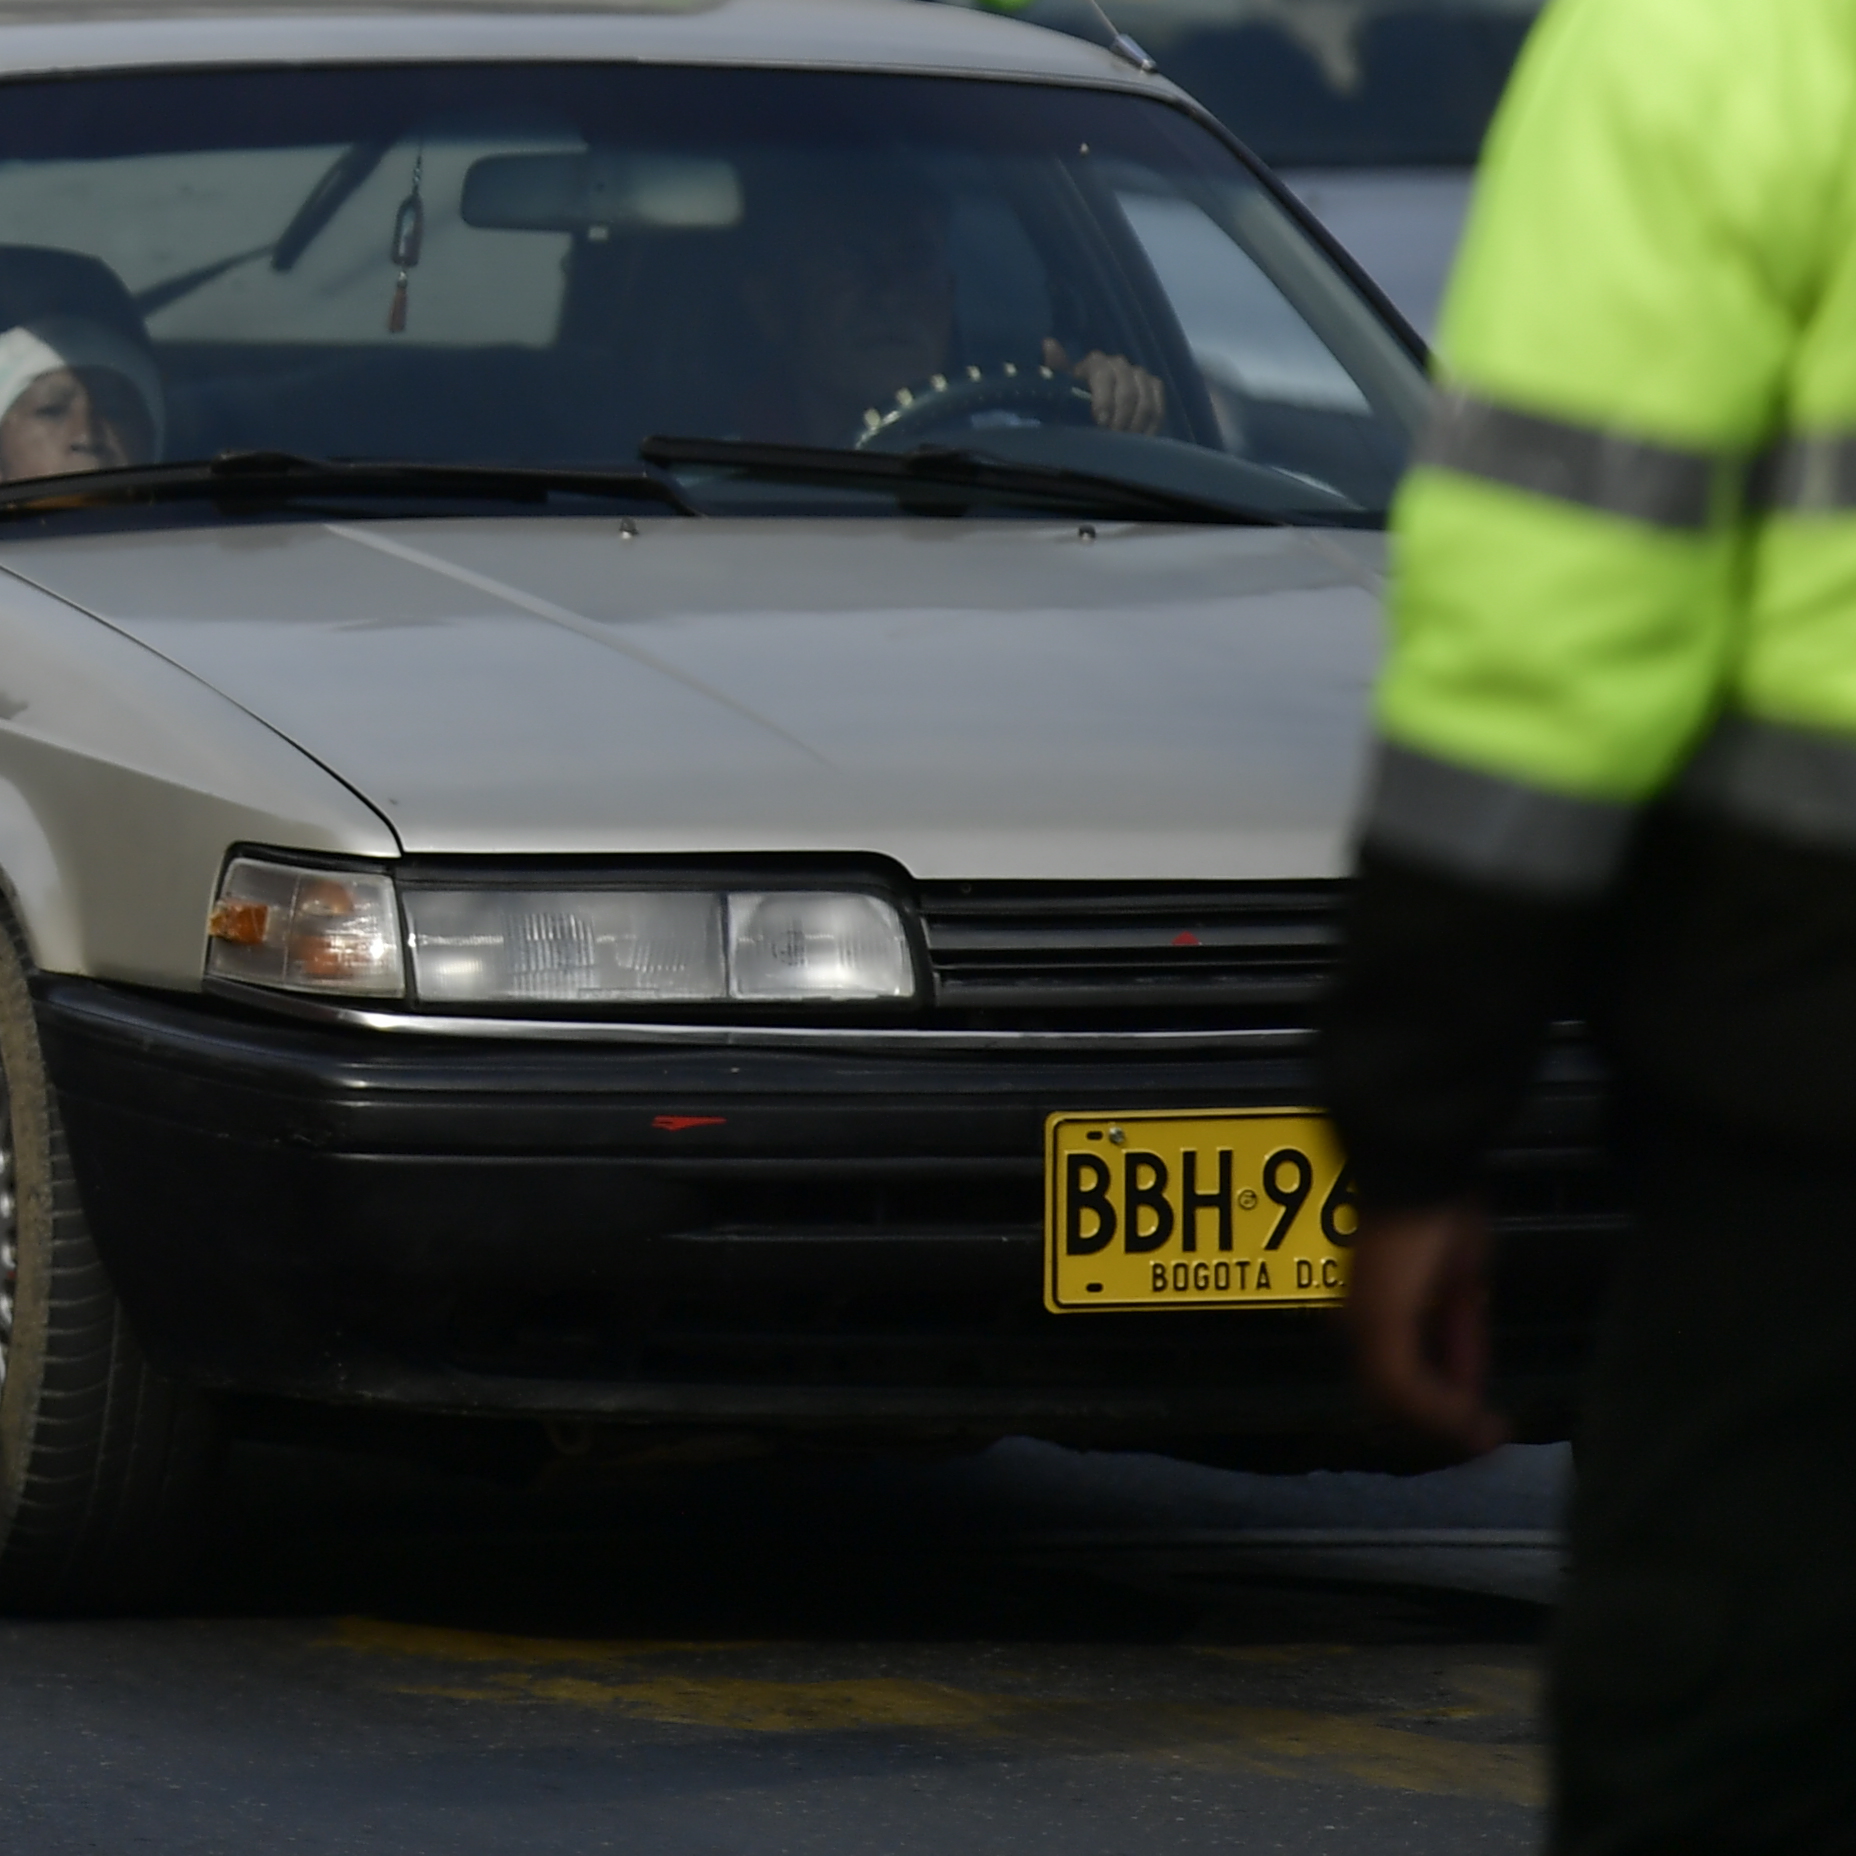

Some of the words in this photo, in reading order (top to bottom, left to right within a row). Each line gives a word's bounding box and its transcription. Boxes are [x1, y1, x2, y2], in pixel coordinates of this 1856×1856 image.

[1065, 1147, 1234, 1257] BBH
[1262, 1147, 1359, 1251] 96
[1151, 1259, 1272, 1293] BOGOTA
[1295, 1258, 1346, 1289] D.C.
